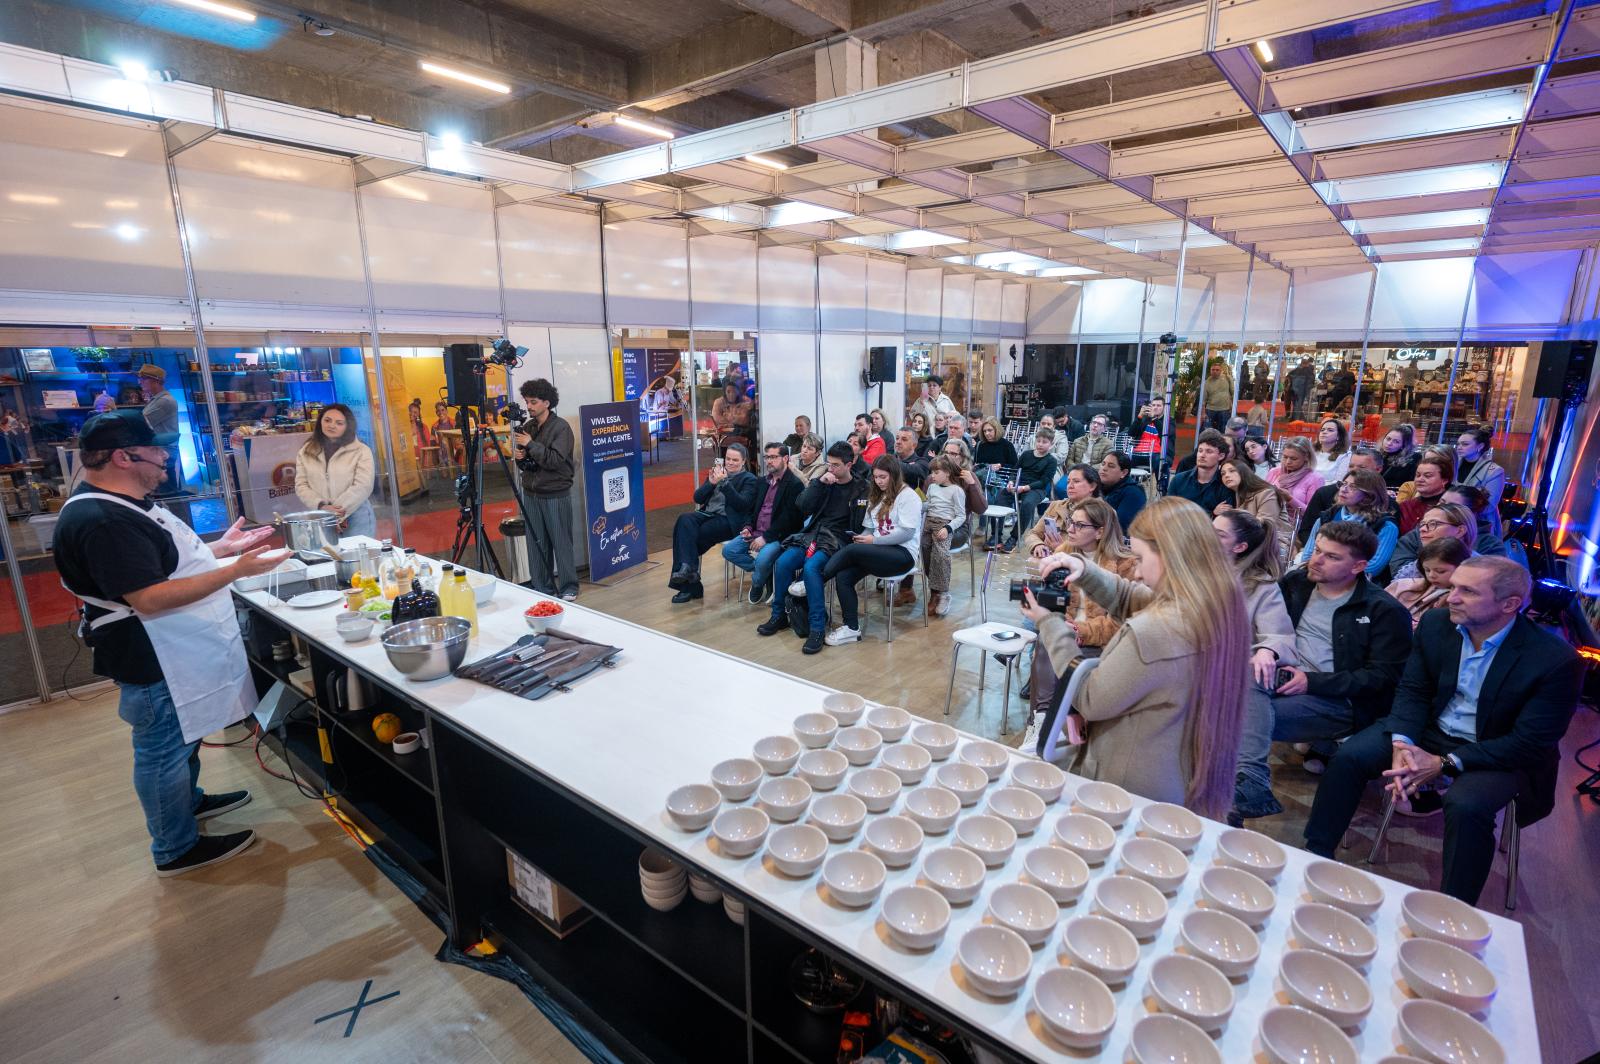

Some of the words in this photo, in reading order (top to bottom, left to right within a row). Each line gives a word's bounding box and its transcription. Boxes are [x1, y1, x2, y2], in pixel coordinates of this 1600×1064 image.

[591, 417, 606, 426] VIVA
[607, 416, 620, 424] ESSA
[592, 424, 629, 435] EXPERIÊNCIA
[613, 434, 632, 442] GENTE.
